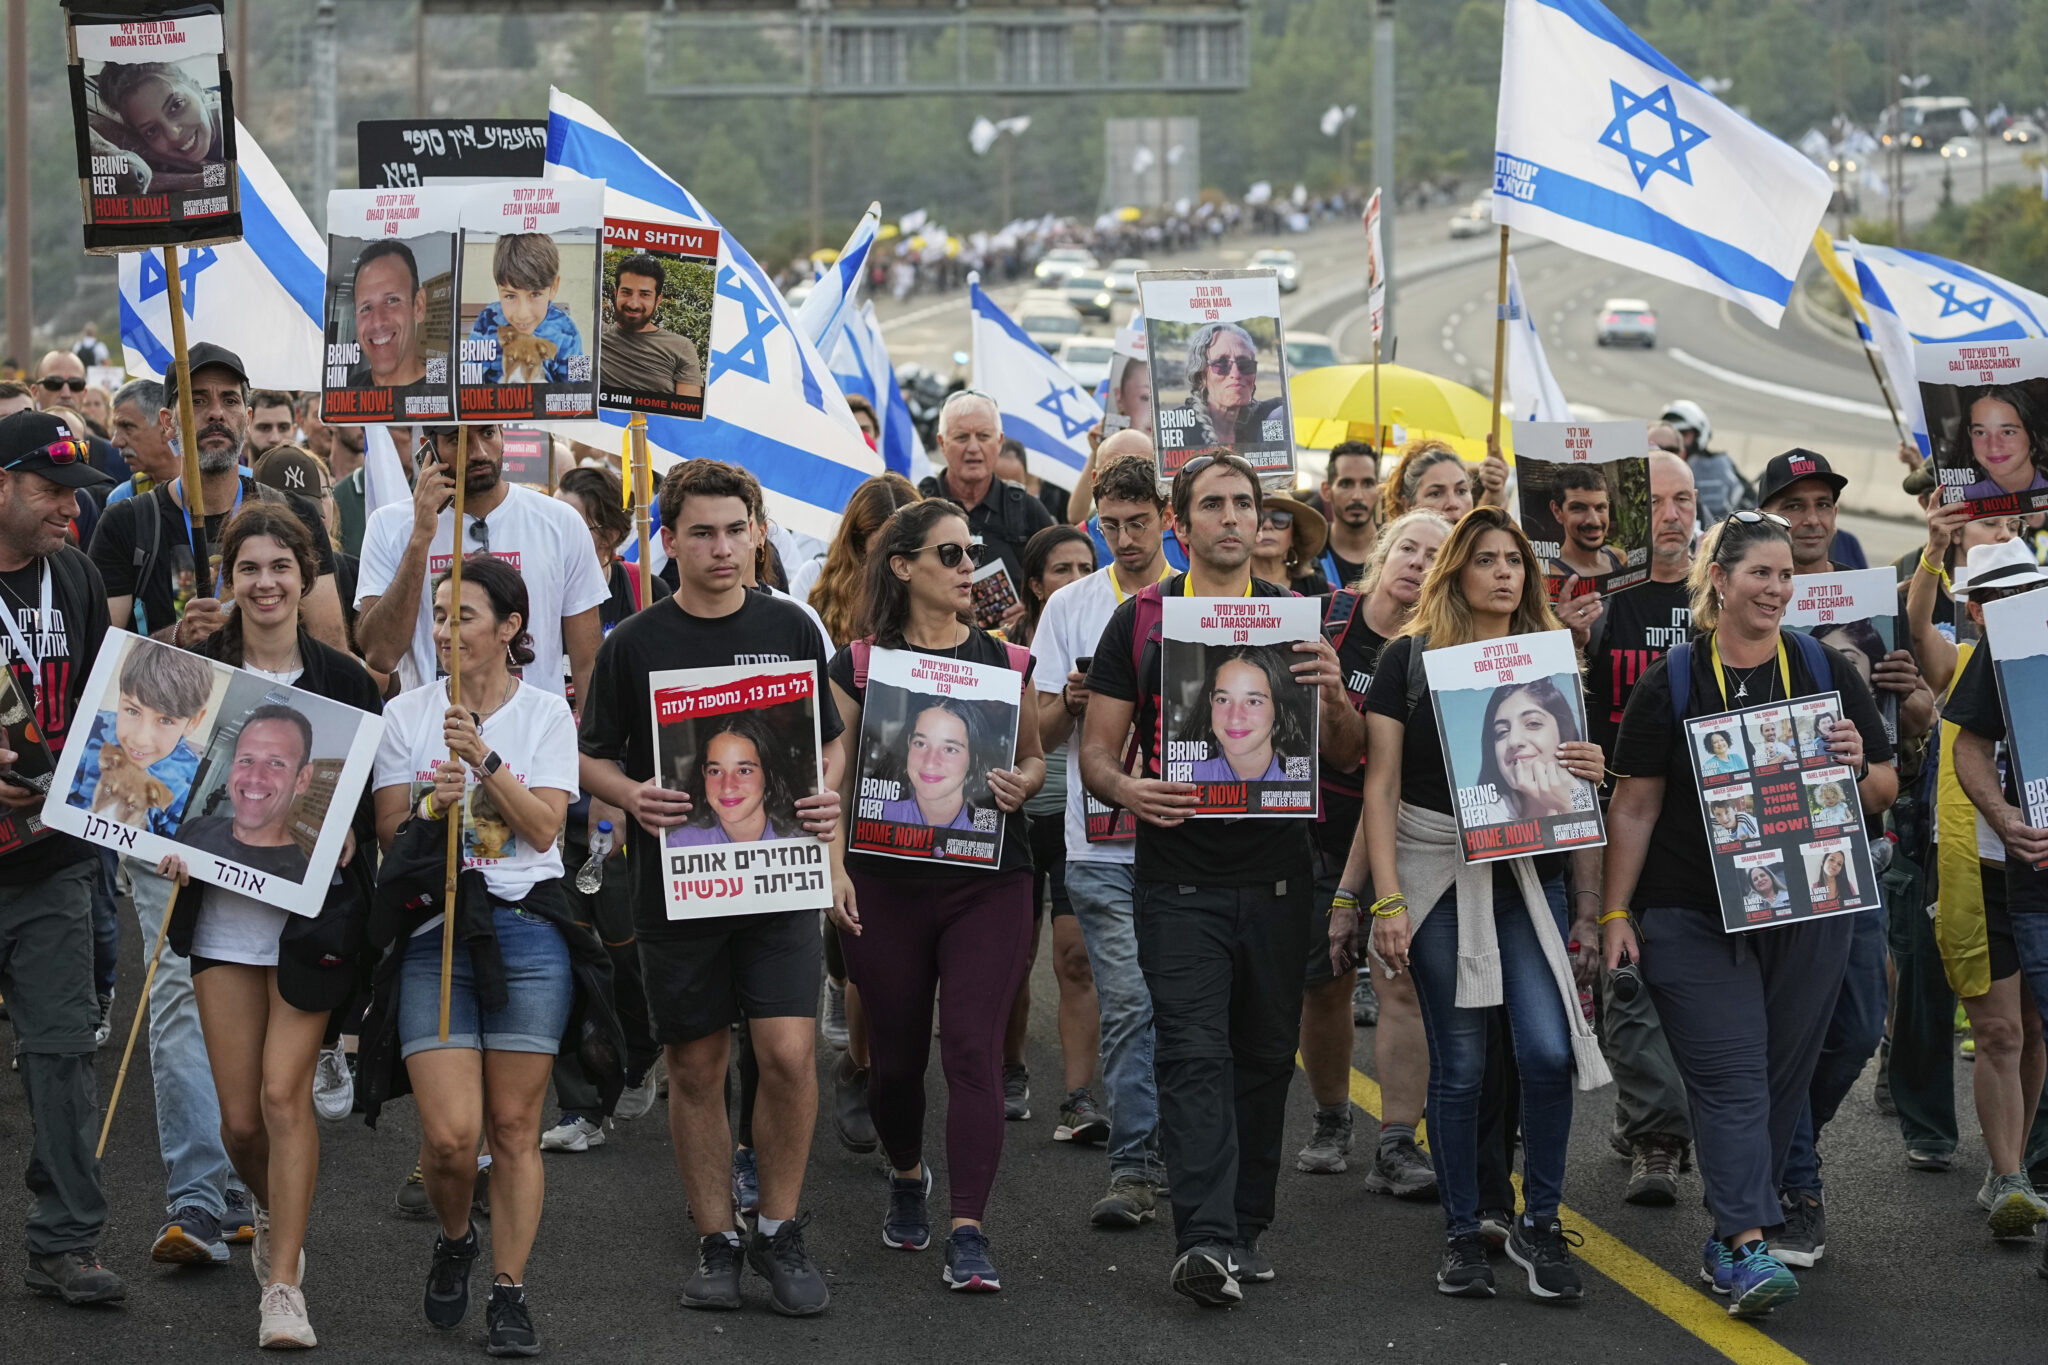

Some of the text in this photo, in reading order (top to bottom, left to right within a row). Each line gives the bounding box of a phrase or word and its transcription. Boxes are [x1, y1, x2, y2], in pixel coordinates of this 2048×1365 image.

[120, 21, 175, 35] מורן סטלה ינאי
[110, 32, 186, 47] MORAN STELA YANAI
[91, 155, 129, 175] BRING
[93, 176, 117, 195] HER
[96, 193, 170, 217] HOME NOW!
[184, 203, 229, 216] FAMILIES FORUM
[366, 207, 420, 221] OHAD YAHALOMI
[503, 201, 560, 216] EITAN YAHALOMI
[384, 221, 398, 235] (49)
[523, 216, 537, 230] (12)
[604, 225, 703, 249] DAN SHTIVI
[1190, 297, 1232, 308] GOREN MAYA
[1205, 309, 1219, 320] (56)
[327, 342, 361, 365] BRING
[460, 339, 497, 362] BRING
[460, 362, 483, 385] HIM
[1949, 358, 2021, 372] GALI TARASCHANSKY
[326, 366, 348, 388] HIM
[1980, 371, 1994, 383] (13)
[325, 387, 394, 413] HOME NOW!
[460, 384, 533, 411] HOME NOW!
[545, 400, 592, 413] FAMILIES FORUM
[610, 394, 632, 404] HIM
[634, 396, 668, 409] HOME
[670, 401, 700, 413] NOW!
[405, 402, 449, 414] FAMILIES FORUM
[1160, 409, 1196, 429] BRING
[1161, 429, 1185, 448] HER
[1565, 439, 1593, 448] OR LEVY
[1164, 450, 1195, 469] HOM
[1269, 457, 1288, 466] FORUM
[1573, 450, 1587, 461] (33)
[1790, 460, 1816, 473] NOW
[285, 465, 305, 488] NY
[1939, 467, 1976, 487] BRING
[1942, 486, 1967, 504] HER
[1981, 494, 2020, 512] NOW!
[1808, 584, 1843, 598] עדן זכריה
[1797, 596, 1854, 611] EDEN ZECHARYA
[1201, 617, 1282, 628] GALI TARASCHANSKY
[1819, 610, 1834, 621] (28)
[1233, 630, 1248, 642] (13)
[1474, 653, 1532, 673] EDEN ZECHARYA
[911, 668, 979, 687] GALI TARSHANSKY
[1498, 670, 1514, 683] (28)
[768, 683, 786, 698] בת
[789, 678, 808, 694] גלי
[936, 682, 951, 694] (13)
[661, 695, 695, 716] לעזה
[698, 691, 741, 710] נחטפה
[1168, 740, 1208, 761] BRING
[1168, 762, 1193, 782] HER
[860, 777, 901, 801] BRING
[1208, 782, 1247, 805] NOW!
[1457, 783, 1499, 808] BRING
[1761, 782, 1797, 796] BRING
[1261, 798, 1311, 807] FAMILIES FORUM
[1763, 792, 1798, 805] THEM
[858, 798, 884, 820] HER
[1461, 807, 1488, 829] HER
[1764, 803, 1800, 816] HOME
[83, 815, 138, 849] איתן
[1554, 826, 1600, 841] FAMILIES FORUM
[1763, 816, 1810, 835] NOW!
[856, 821, 934, 849] HOME NOW!
[1466, 819, 1542, 851] HOME NOW!
[671, 844, 822, 875] מחזירים אותם
[946, 845, 993, 859] FAMILIES FORUM
[214, 861, 266, 894] אוהד
[673, 870, 824, 902] הביתה עכשיו!
